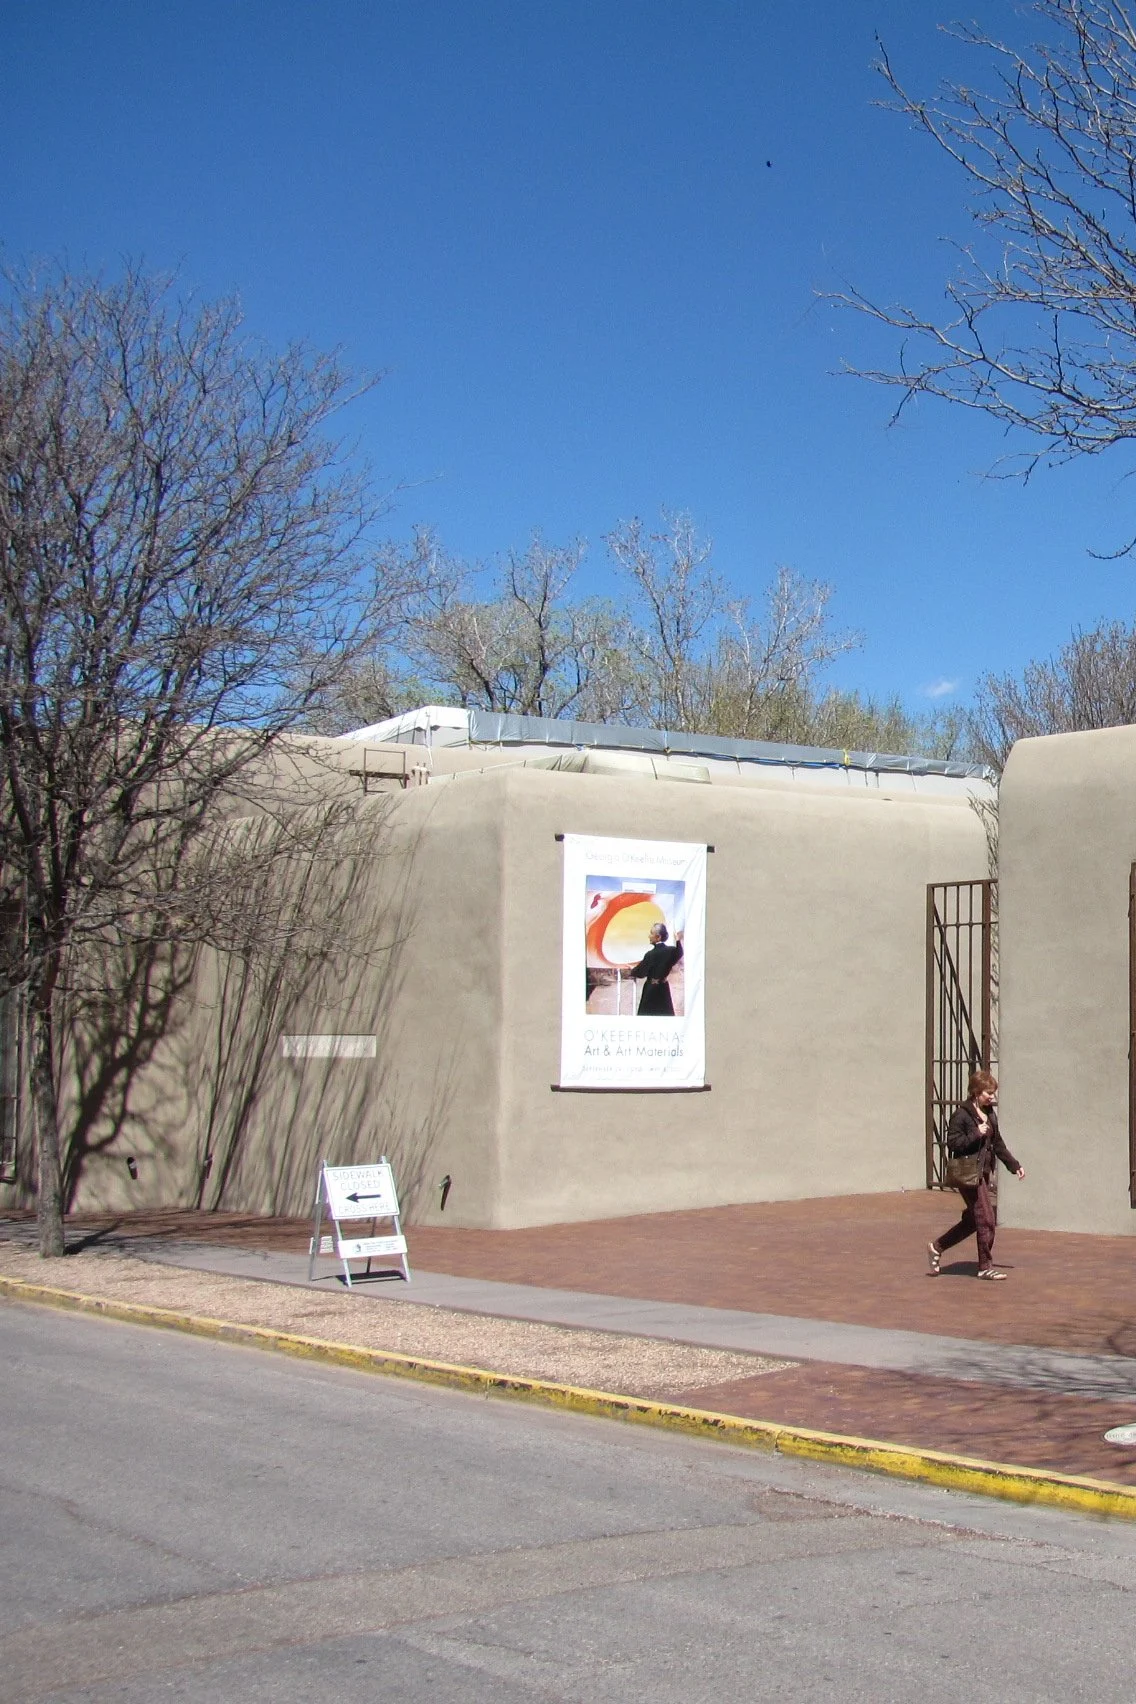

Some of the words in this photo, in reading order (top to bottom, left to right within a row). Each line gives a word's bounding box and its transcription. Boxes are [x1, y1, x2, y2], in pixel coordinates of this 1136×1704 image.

[585, 851, 619, 865] Georgia
[583, 1044, 600, 1056] Art
[603, 1044, 611, 1057] &
[615, 1044, 632, 1056] Art
[636, 1044, 684, 1057] Materials
[332, 1169, 384, 1181] SIDEWALK
[340, 1180, 381, 1191] CLOSED
